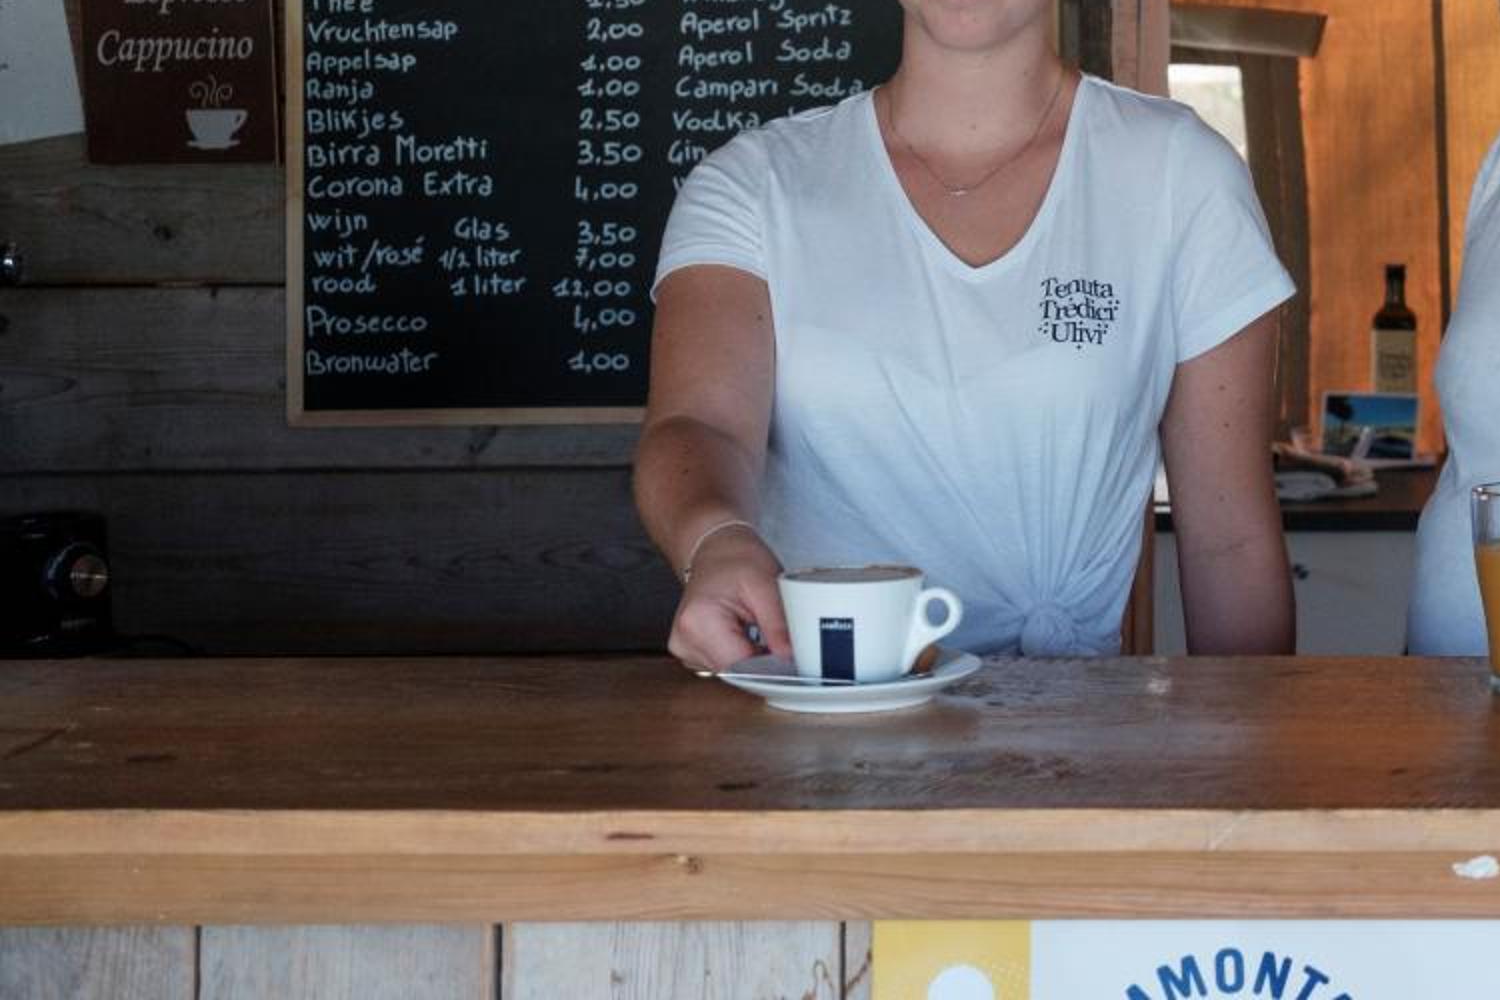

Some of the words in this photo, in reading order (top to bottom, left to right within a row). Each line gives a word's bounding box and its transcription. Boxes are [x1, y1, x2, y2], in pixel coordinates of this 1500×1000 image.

[307, 19, 458, 43] Vruchtensap
[587, 17, 644, 42] 2,00
[680, 8, 759, 40] Aperol
[775, 5, 853, 31] Spritz
[97, 28, 252, 72] Cappucino
[306, 48, 417, 75] Appelsap
[678, 41, 753, 72] Aperol
[775, 36, 852, 62] Soda
[306, 78, 374, 104] Ranja
[675, 75, 778, 102] Campari
[789, 73, 866, 98] Soda
[307, 141, 380, 168] Birra
[395, 134, 488, 166] Moretti
[577, 139, 641, 166] 3,50
[308, 174, 403, 198] Corona
[423, 171, 493, 197] Extra
[575, 176, 639, 201] 4,00
[307, 209, 368, 238] wijn
[454, 216, 510, 242] Glas
[577, 220, 636, 246] 3,50
[476, 244, 522, 268] liter
[311, 274, 377, 295] rood
[450, 277, 467, 296] 1
[474, 272, 528, 296] liter
[1041, 277, 1113, 298] Tenuta
[306, 306, 428, 336] Prosecco
[574, 304, 636, 332] 4,00
[1040, 298, 1116, 321] Tredici
[1051, 321, 1105, 344] Ulivi
[306, 348, 439, 376] Bronwater
